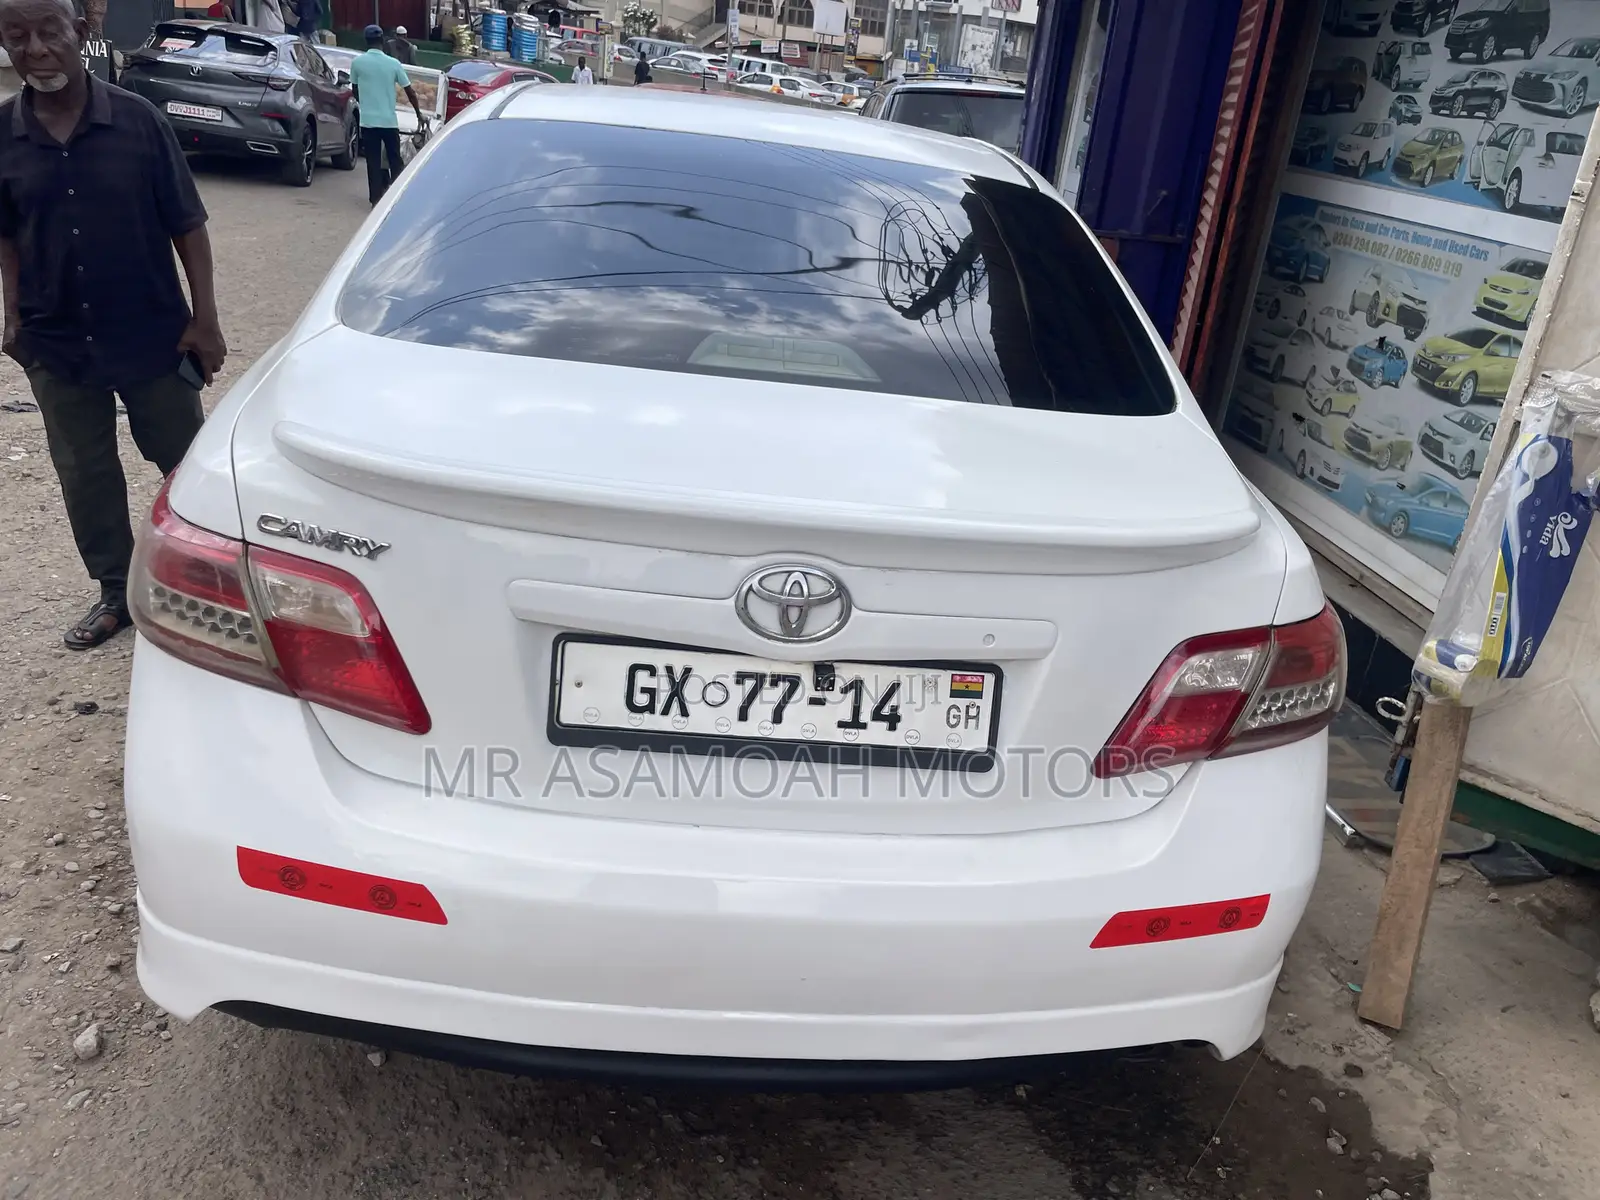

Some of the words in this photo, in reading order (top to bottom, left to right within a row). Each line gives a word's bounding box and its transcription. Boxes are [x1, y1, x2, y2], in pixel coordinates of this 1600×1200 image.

[1395, 247, 1421, 267] 0266
[1421, 254, 1442, 272] 869
[1442, 259, 1463, 278] 919
[1448, 239, 1470, 257] Used
[1469, 245, 1490, 262] Cars
[257, 512, 391, 561] CAMRY
[625, 662, 694, 717] GX
[946, 703, 980, 731] GH
